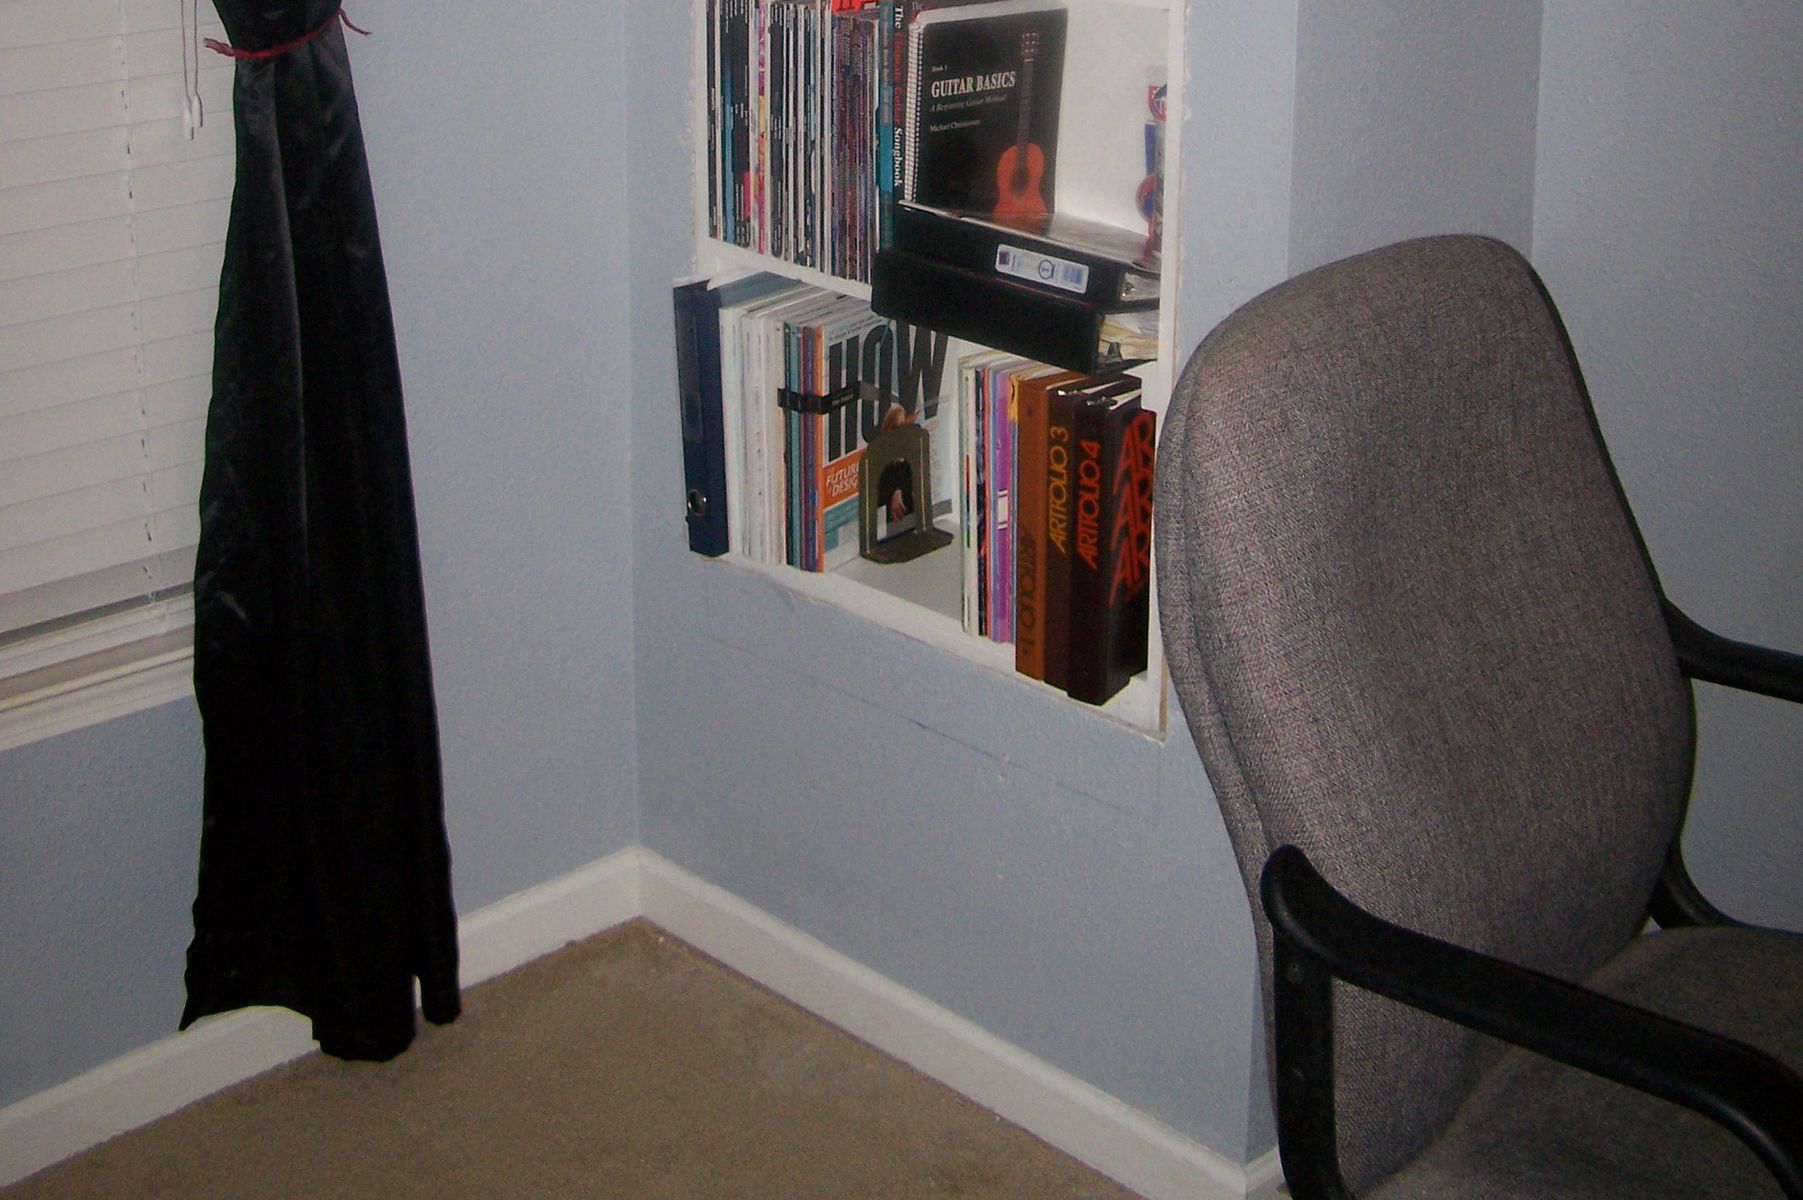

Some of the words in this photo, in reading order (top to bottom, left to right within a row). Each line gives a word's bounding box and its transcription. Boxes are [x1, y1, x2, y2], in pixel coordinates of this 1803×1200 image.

[894, 4, 905, 29] The
[931, 76, 974, 98] GUITAR
[976, 70, 1016, 92] BASICS
[892, 126, 904, 187] Songbook
[828, 318, 949, 463] HOW
[1050, 425, 1069, 443] 3
[1079, 440, 1102, 459] 4
[825, 461, 860, 488] FUTUR
[1048, 446, 1068, 555] ARTFOLIO
[1076, 459, 1101, 570] ARTFOLIO
